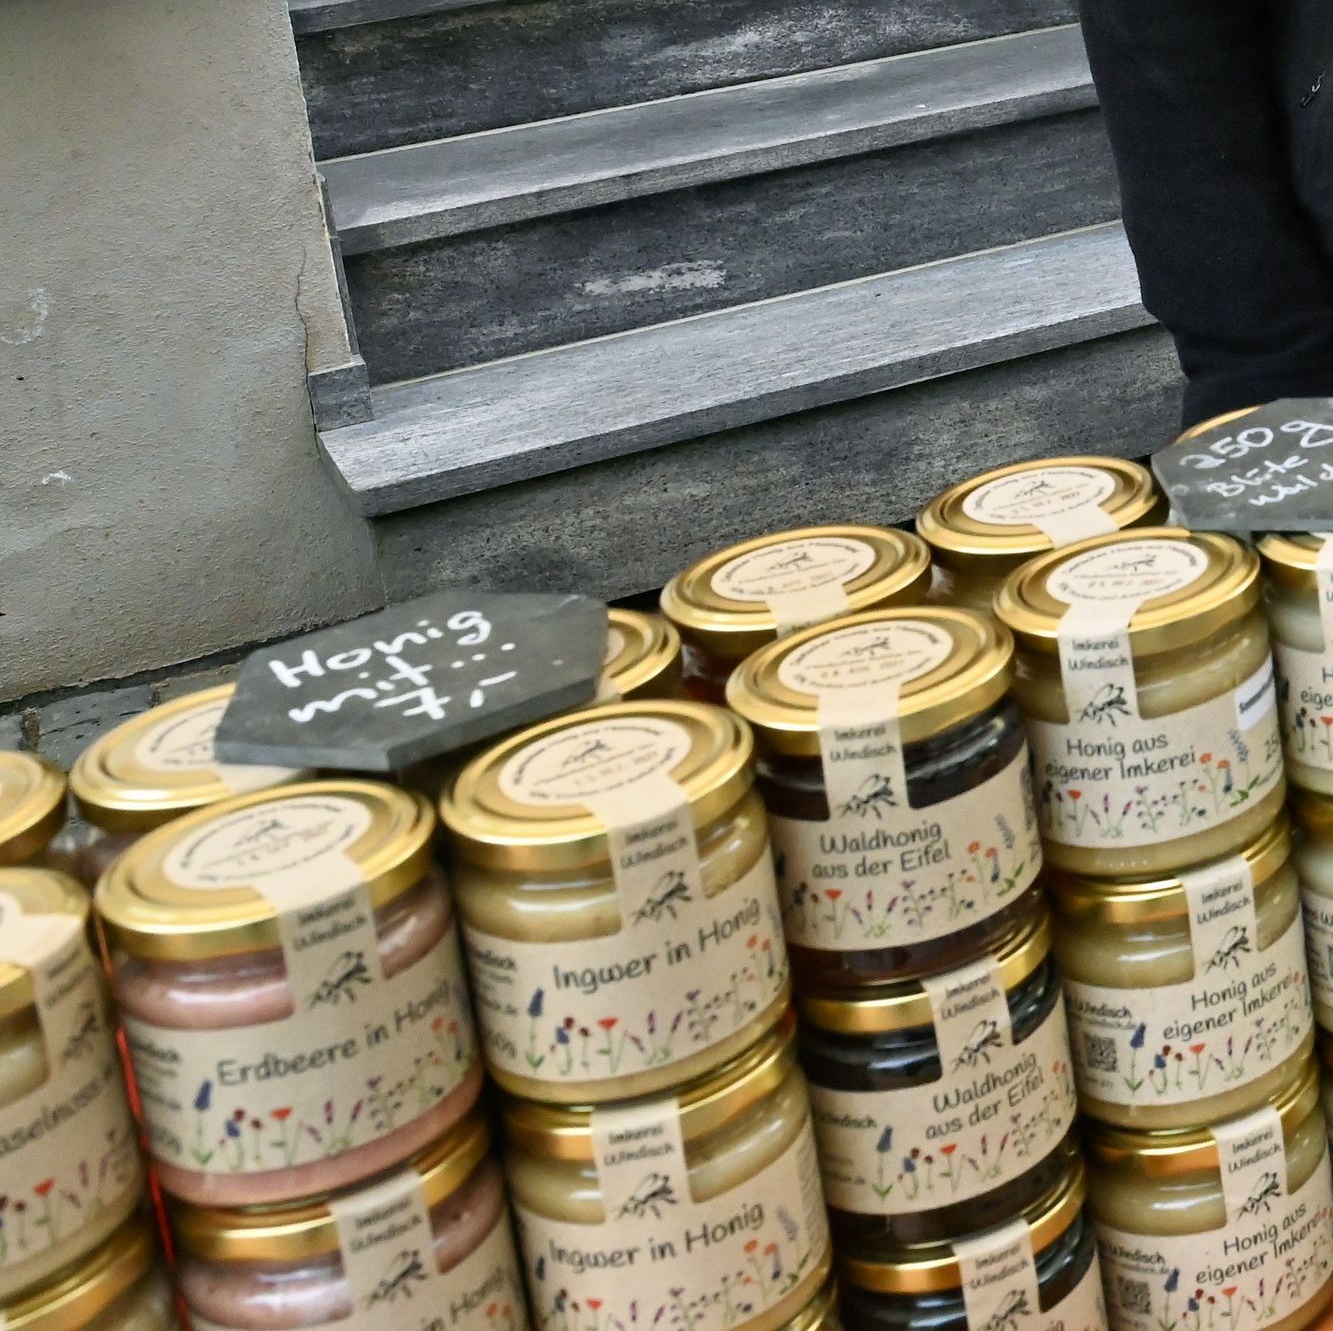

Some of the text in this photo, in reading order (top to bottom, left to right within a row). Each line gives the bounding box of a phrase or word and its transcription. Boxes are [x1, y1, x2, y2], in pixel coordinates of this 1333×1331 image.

[269, 610, 493, 688] Honig
[1045, 748, 1196, 784] eigener Imkerei
[1066, 734, 1169, 761] Honig aus
[812, 843, 953, 879] aus der Eifel
[819, 820, 943, 856] Waldhonig
[552, 895, 763, 996] Ingwer in Honig
[1191, 976, 1249, 1013] Honig
[1250, 960, 1277, 988] aus
[1162, 1009, 1237, 1042] eigener
[216, 1023, 390, 1087] Erdbeere in
[925, 1066, 1046, 1141] aus der Eifel
[933, 1051, 1038, 1114] Waldhonig
[549, 1200, 766, 1275] Ingwer in Honig
[1224, 1203, 1307, 1257] Honig aus
[1195, 1252, 1267, 1285] eigener
